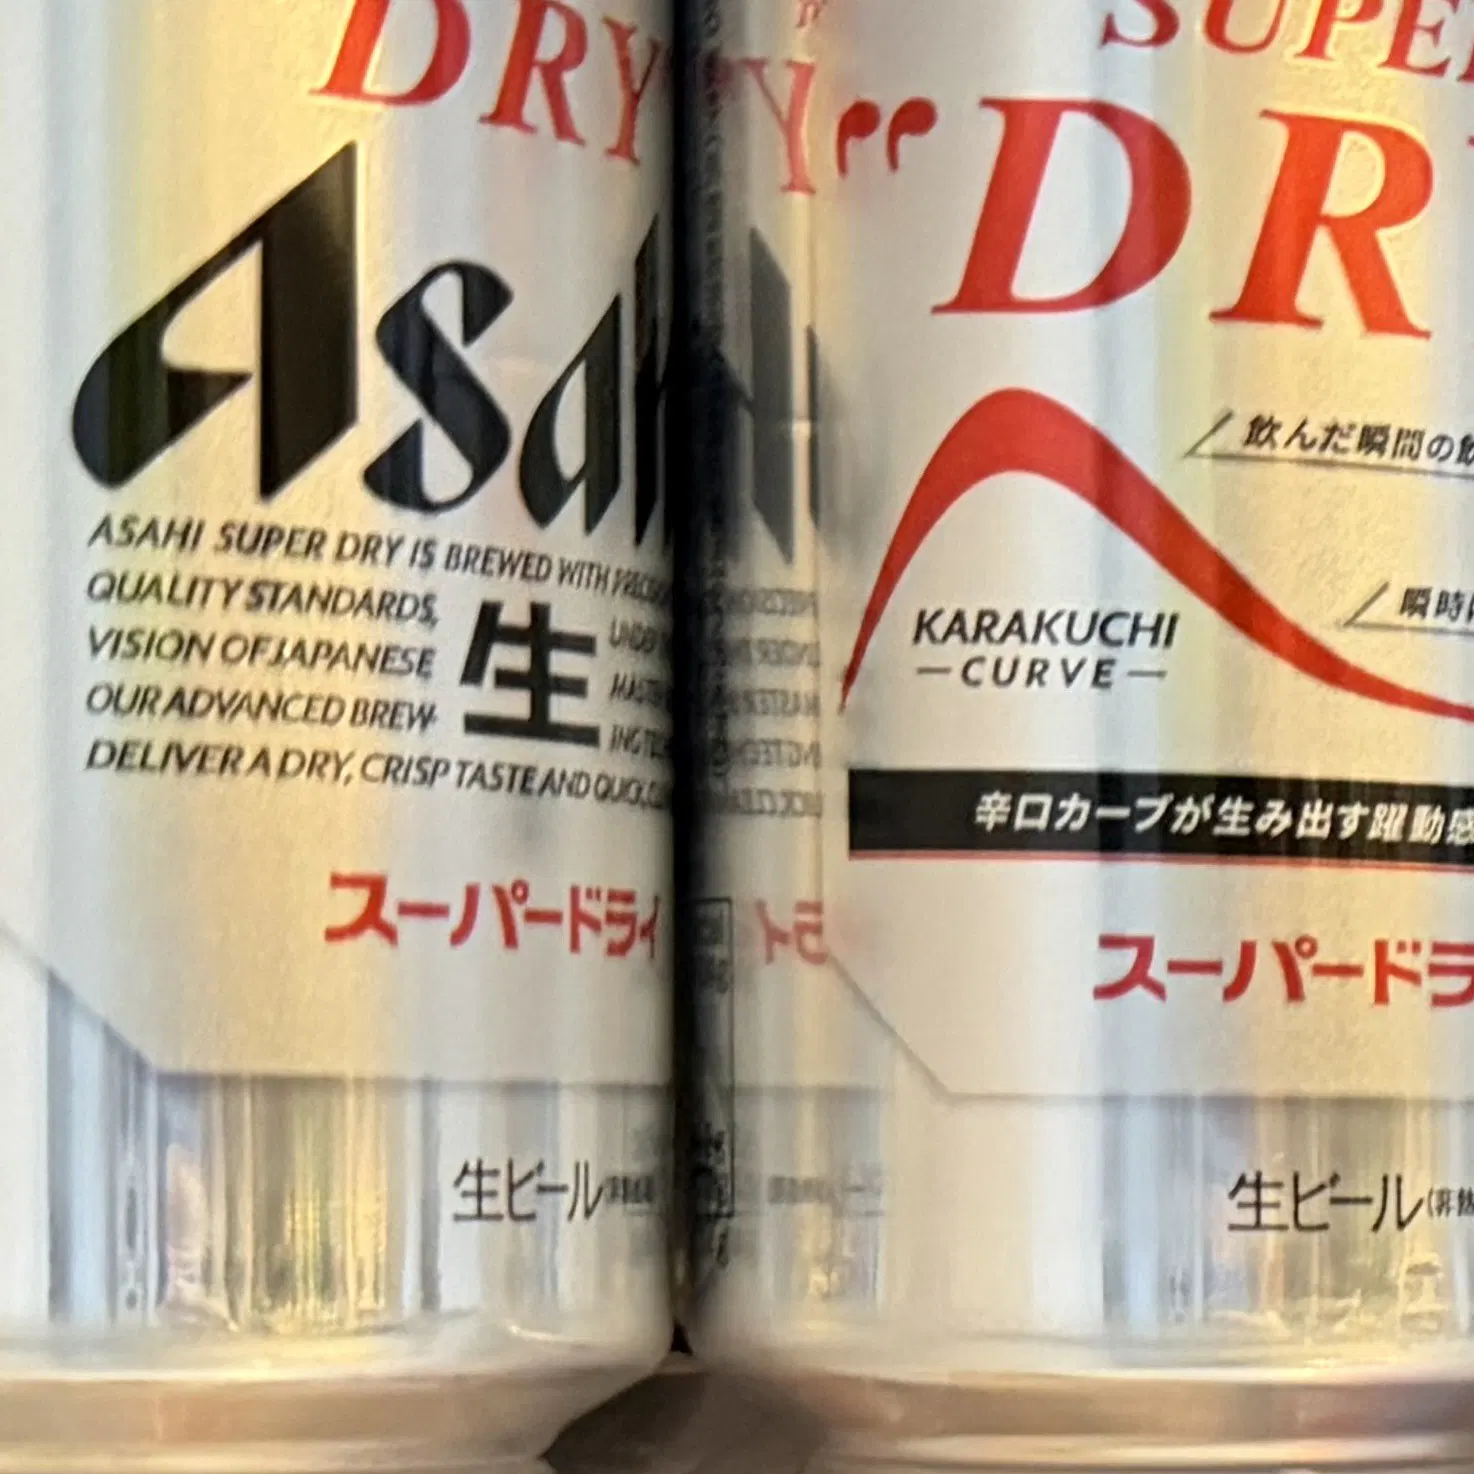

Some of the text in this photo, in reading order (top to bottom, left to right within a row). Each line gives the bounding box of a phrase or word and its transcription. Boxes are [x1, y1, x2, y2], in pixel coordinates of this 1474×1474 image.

[87, 513, 205, 553] ASAHI
[214, 518, 327, 560] SUPER
[335, 529, 404, 567] DRY
[409, 537, 437, 571] IS
[444, 543, 553, 582] BREWED
[558, 557, 610, 592] WITH
[86, 569, 439, 628] QUALITY STANDARDS,
[912, 607, 1179, 648] KARAKUCHI
[89, 625, 436, 681] VISION OF JAPANESE
[459, 600, 600, 748] 生
[961, 656, 1116, 690] CURVE
[85, 682, 162, 717] OUR
[162, 686, 346, 726] ADVANCED
[85, 738, 244, 775] DELIVER
[247, 747, 271, 778] A
[277, 747, 355, 788] DRY,
[360, 752, 450, 789] CRISP
[455, 759, 539, 795] TASTE
[539, 767, 591, 798] AND
[324, 871, 661, 960] スーパードライ
